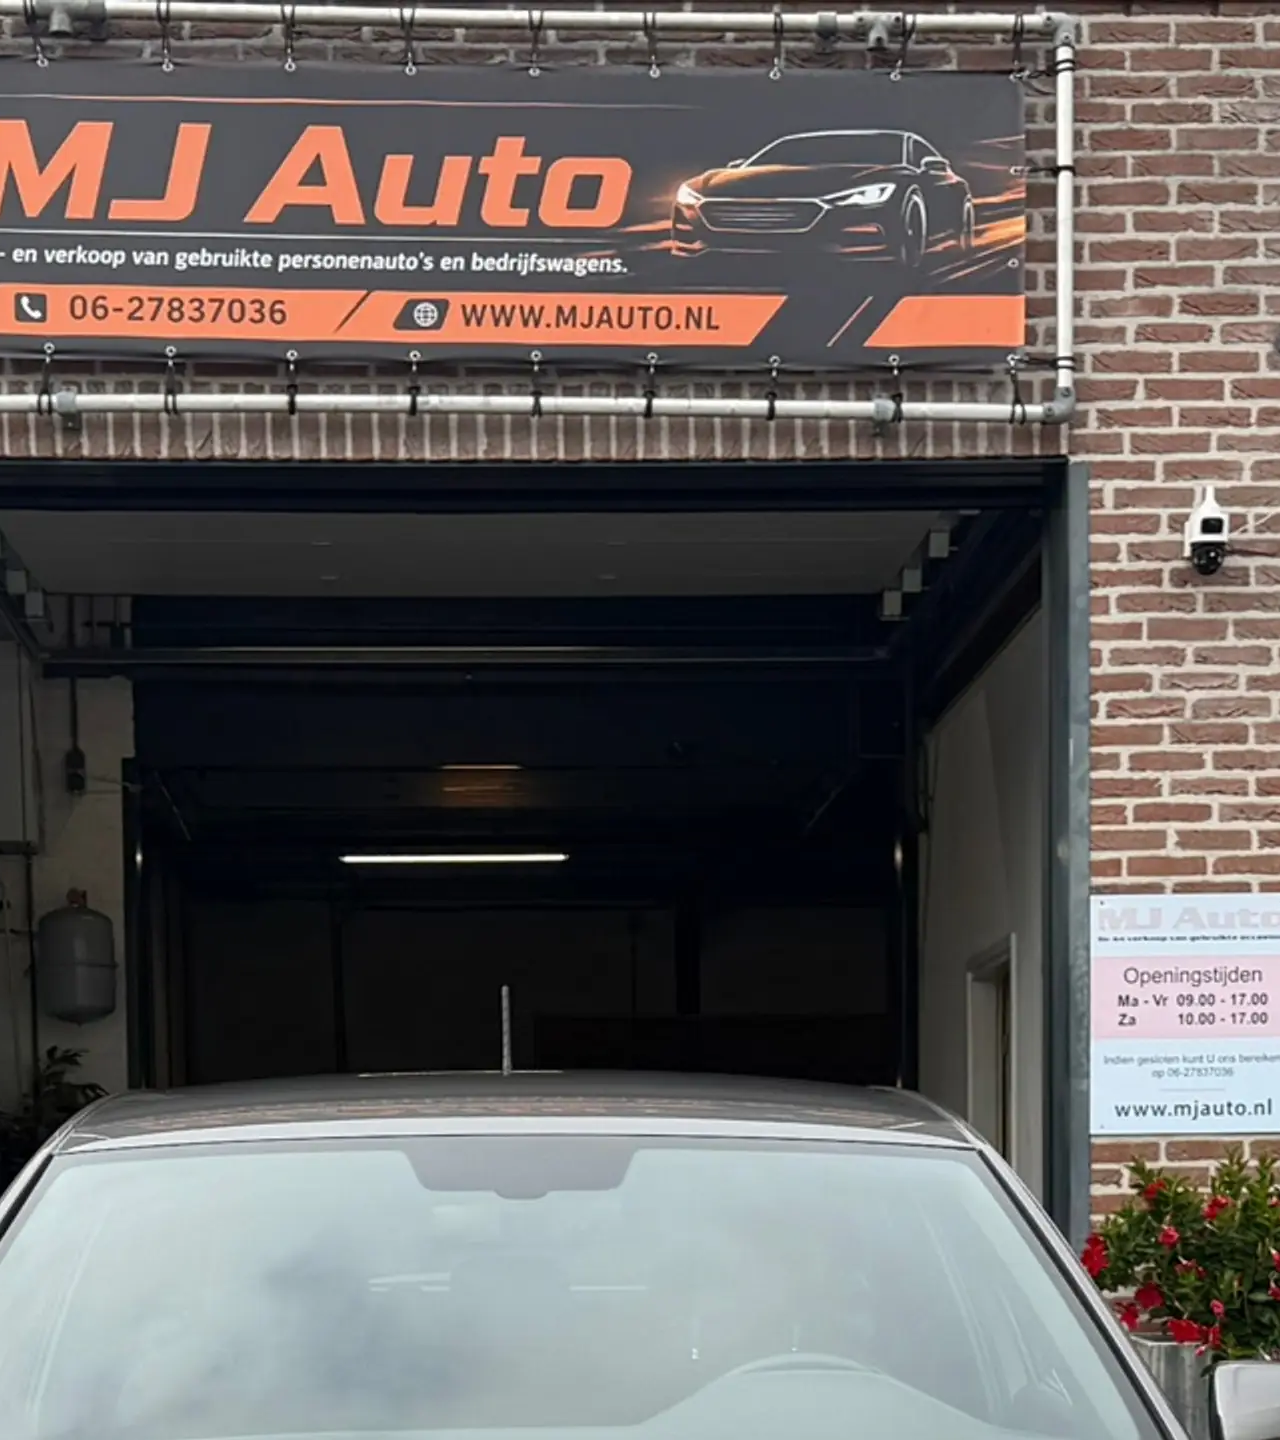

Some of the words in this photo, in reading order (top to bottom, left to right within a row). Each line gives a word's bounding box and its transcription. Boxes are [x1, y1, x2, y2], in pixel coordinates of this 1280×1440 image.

[242, 124, 633, 228] Auto
[11, 246, 38, 264] en
[44, 245, 126, 269] verkoop
[132, 250, 169, 267] van
[174, 248, 273, 271] gebruikte
[277, 252, 434, 273] personenauto's
[439, 256, 466, 271] en
[470, 252, 629, 277] bedrijfswagens.
[69, 294, 287, 325] 06-27837036
[460, 304, 720, 331] WWW.MJAUTO.NL
[1098, 907, 1163, 932] MJ
[1123, 966, 1263, 988] Openingstijden
[1118, 994, 1140, 1007] Ma
[1152, 993, 1169, 1007] Vr
[1176, 993, 1216, 1007] 09.00
[1231, 992, 1269, 1006] 17.00
[1118, 1012, 1137, 1026] Za
[1178, 1012, 1216, 1026] 10.00
[1231, 1011, 1269, 1025] 17.00
[1114, 1098, 1272, 1121] www.mjauto.nl
